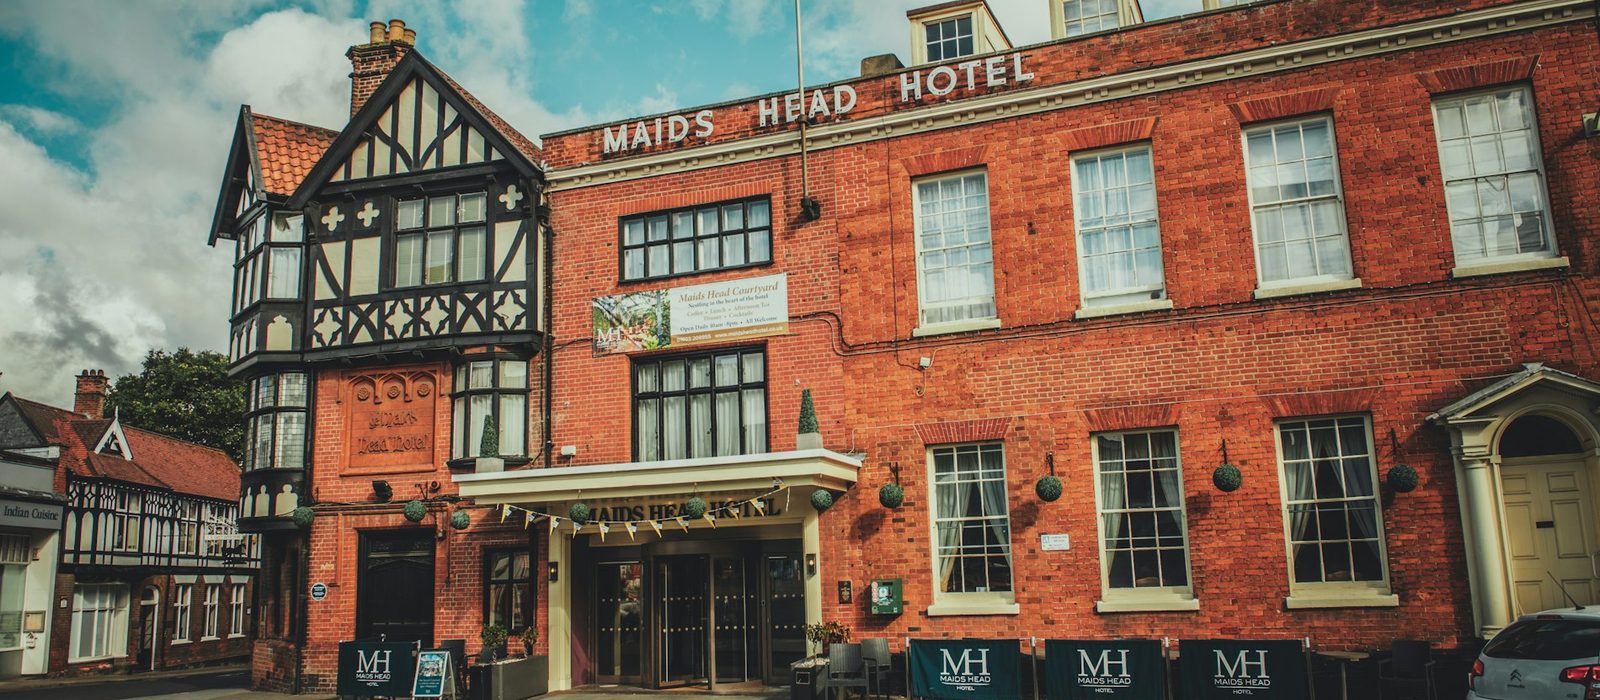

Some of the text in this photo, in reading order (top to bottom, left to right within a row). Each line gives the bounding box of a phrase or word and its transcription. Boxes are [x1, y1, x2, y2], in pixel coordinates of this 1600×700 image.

[602, 53, 1035, 154] MAIDS HEAD HOTEL
[679, 281, 779, 303] Maids Head Courtyard
[4, 505, 59, 520] Indian Cuisine
[648, 502, 691, 522] HEA
[356, 649, 392, 674] MH
[940, 648, 990, 676] MH
[1077, 649, 1130, 677] MH
[1213, 649, 1269, 679] MH
[940, 675, 991, 683] MAIDS HEAD
[1107, 677, 1131, 685] HEAD
[1214, 678, 1270, 686] MAIDS HEAD
